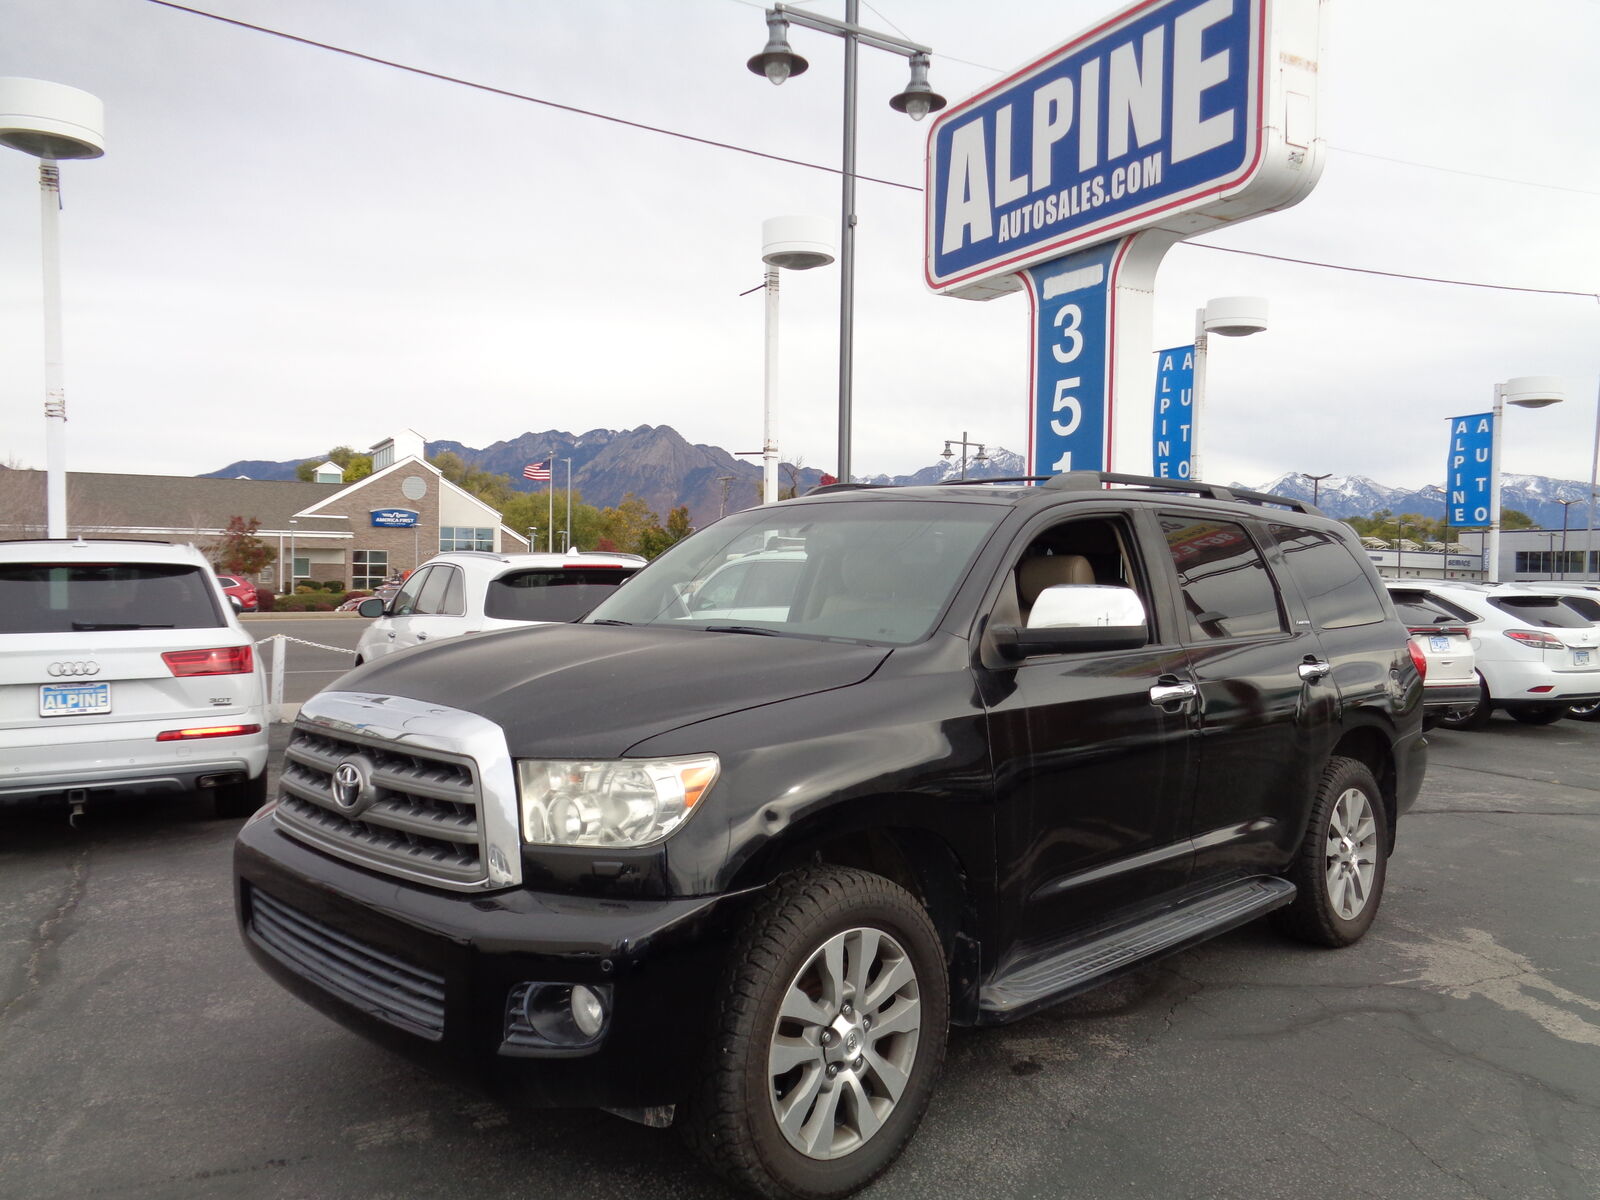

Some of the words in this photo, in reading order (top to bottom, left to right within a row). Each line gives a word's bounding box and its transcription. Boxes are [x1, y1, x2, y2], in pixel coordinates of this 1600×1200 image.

[941, 0, 1234, 256] ALPINE
[998, 152, 1162, 244] AUTOSALES.COM
[1158, 355, 1174, 478] ALPINE
[1178, 352, 1194, 479] AUTO
[1452, 420, 1467, 522] ALPINE
[1474, 418, 1489, 522] AUTO
[45, 693, 107, 708] ALPINE
